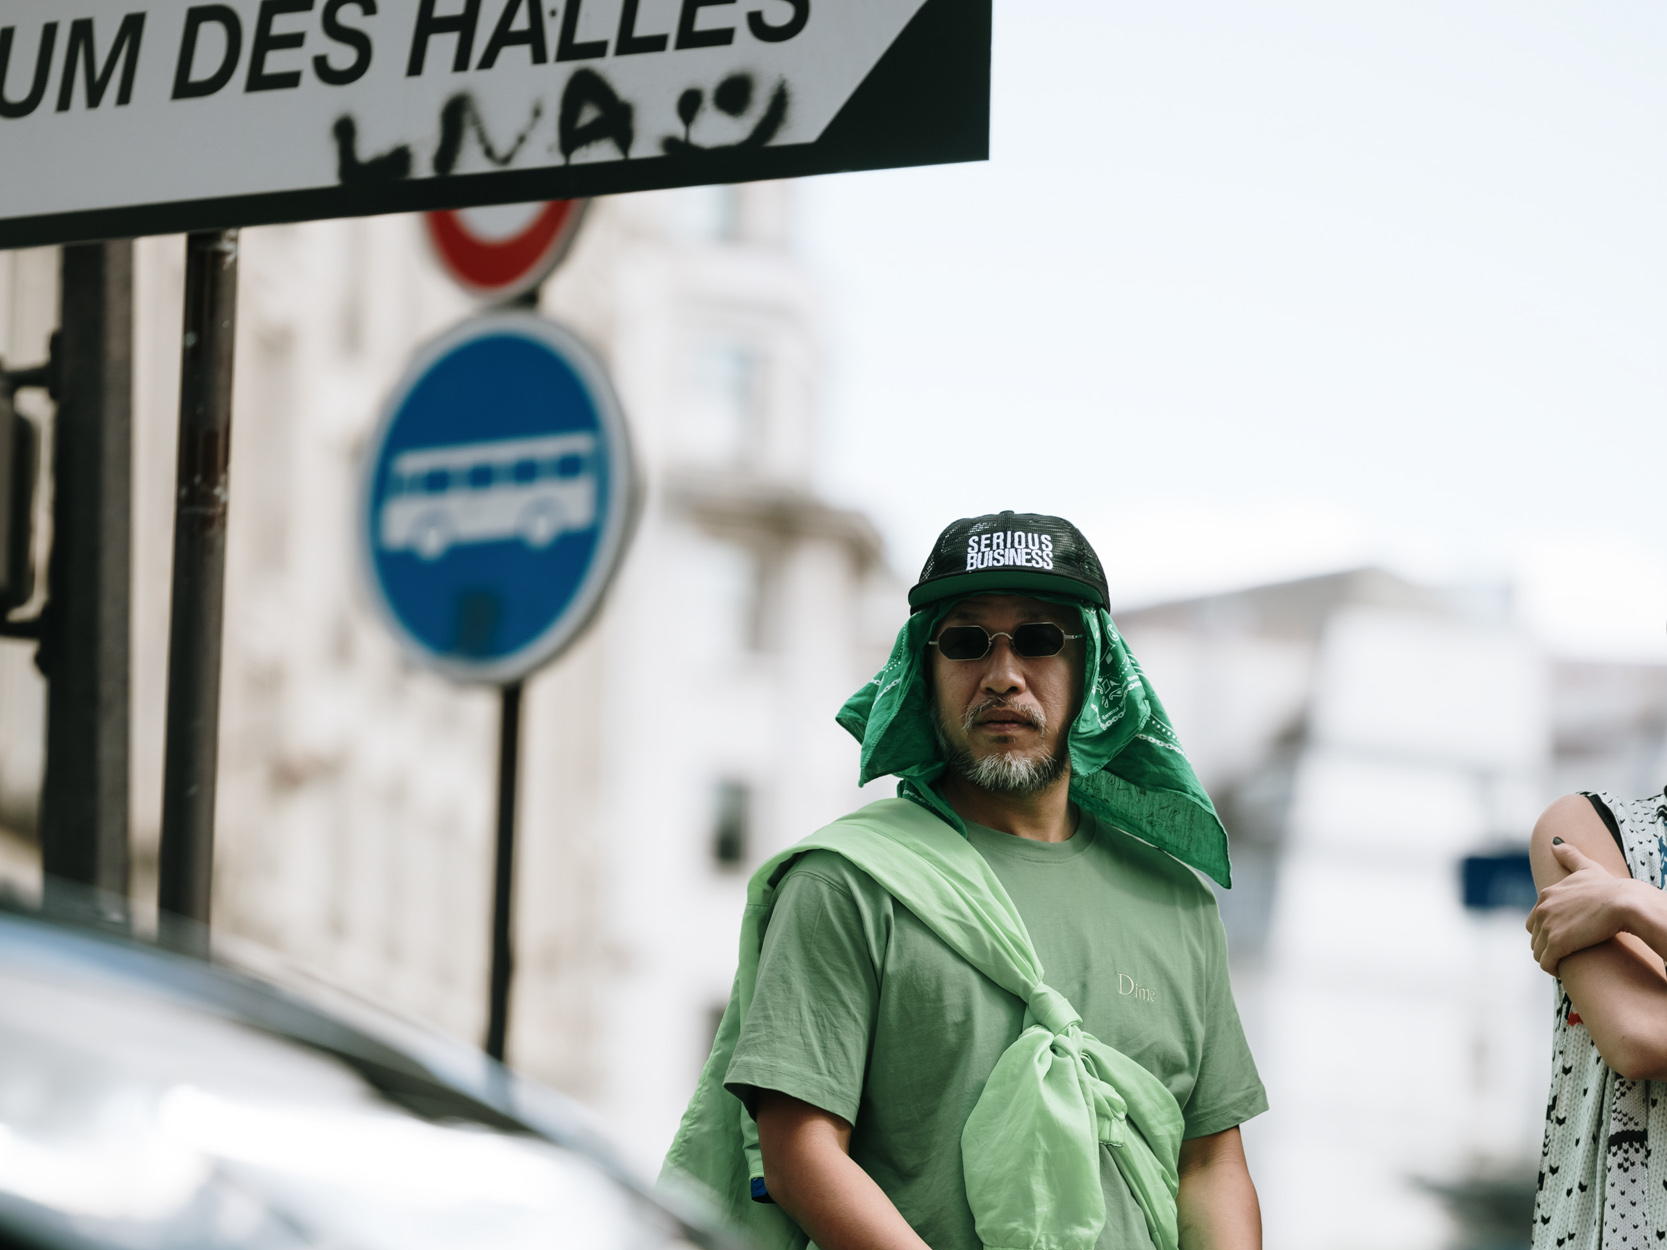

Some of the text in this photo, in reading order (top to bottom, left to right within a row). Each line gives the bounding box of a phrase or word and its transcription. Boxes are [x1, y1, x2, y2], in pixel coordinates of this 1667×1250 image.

[0, 11, 147, 119] UM
[170, 0, 378, 100] DES
[967, 531, 1053, 553] SERIOUS
[966, 548, 1053, 570] BUISINESS
[1117, 972, 1156, 1002] Dime
